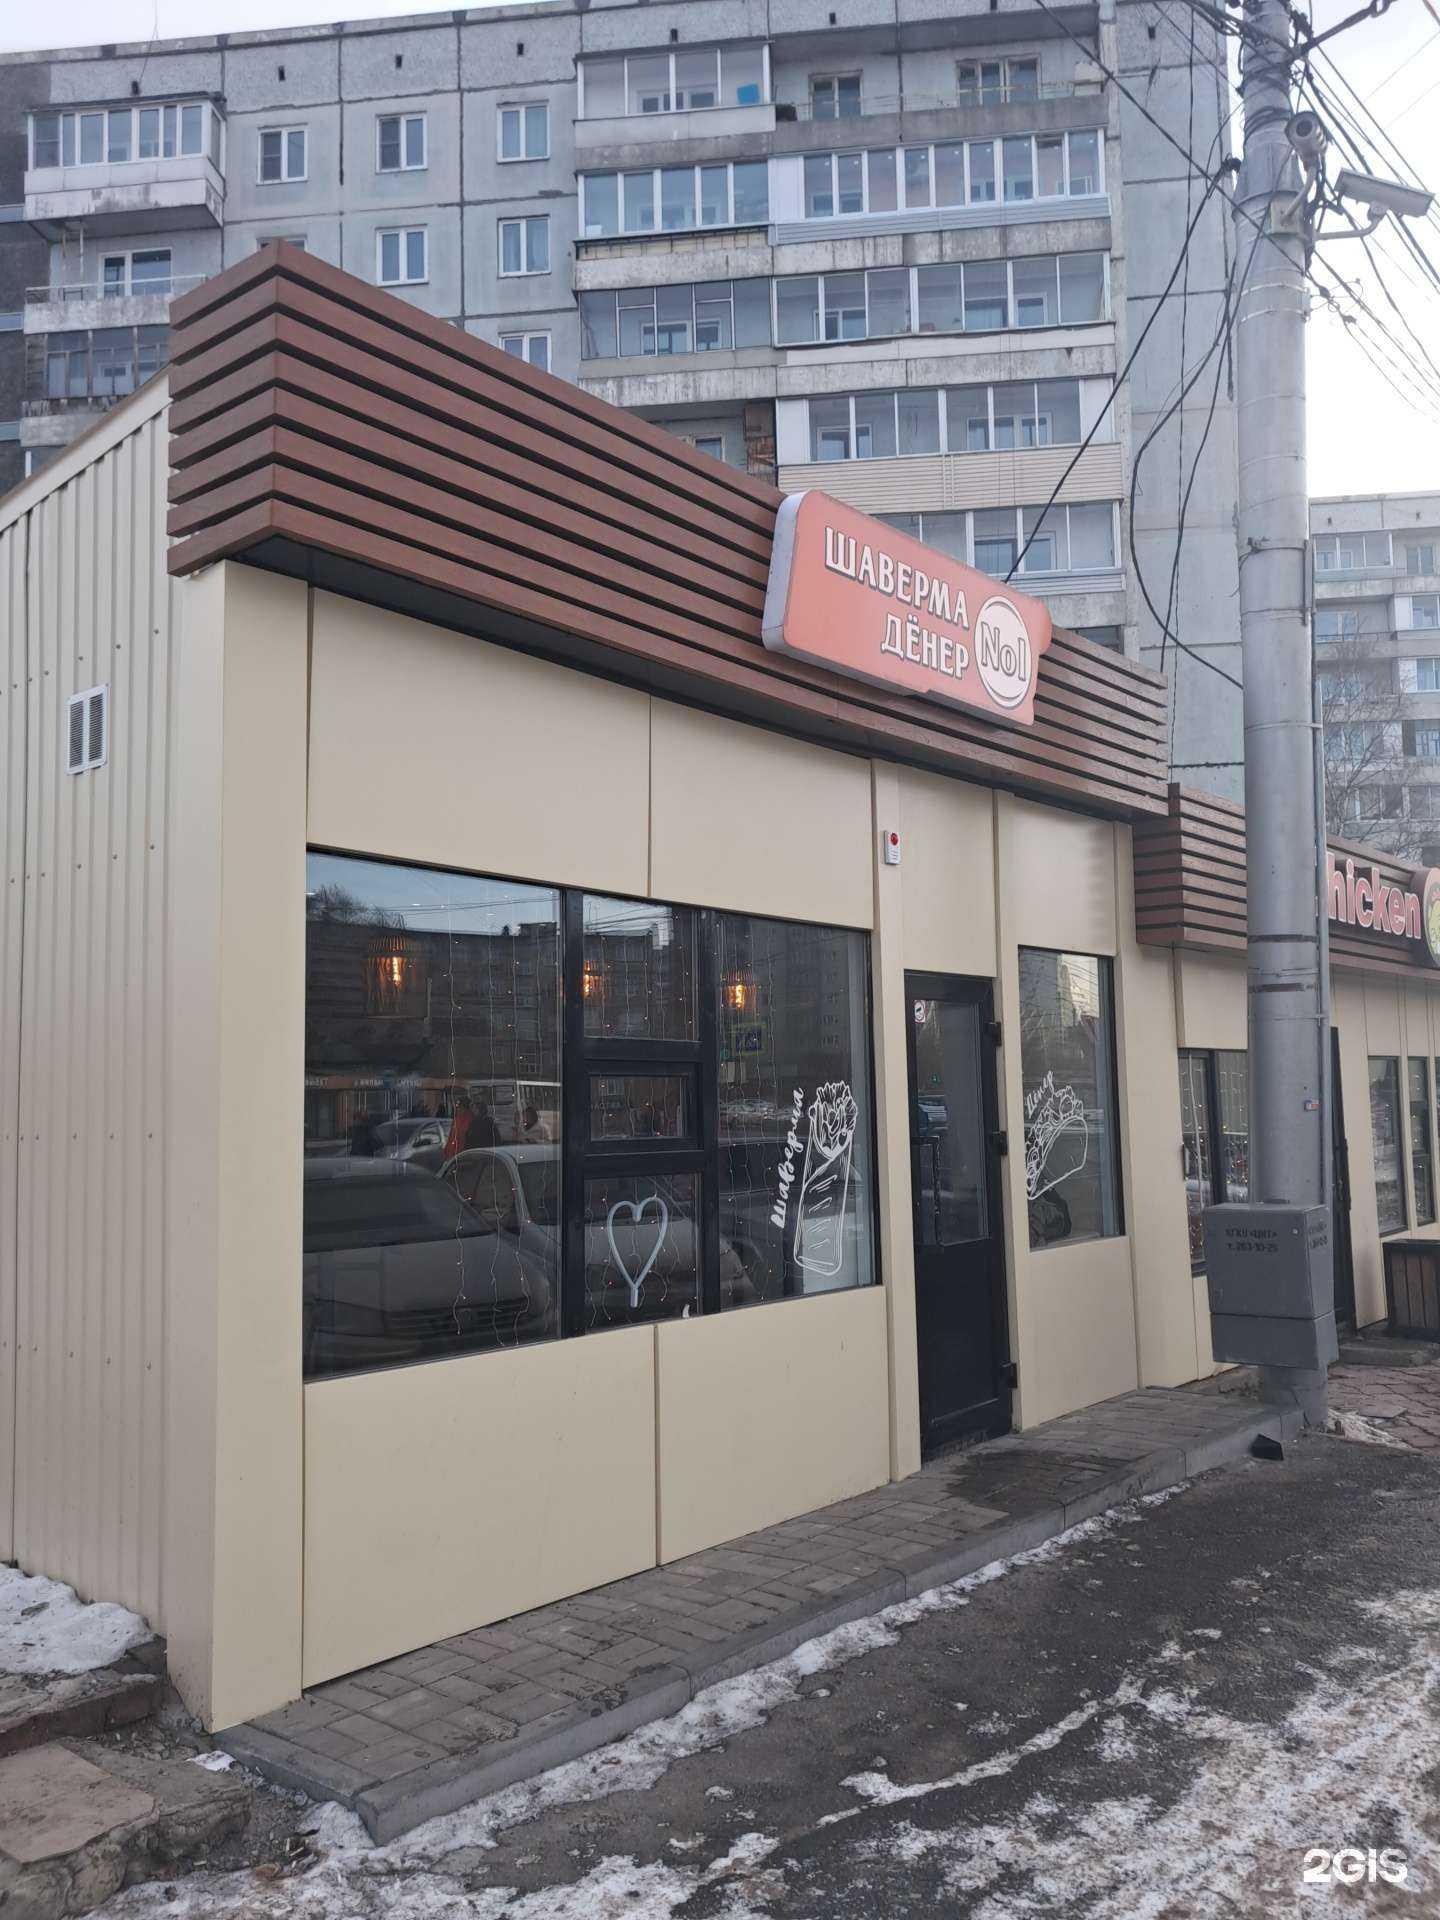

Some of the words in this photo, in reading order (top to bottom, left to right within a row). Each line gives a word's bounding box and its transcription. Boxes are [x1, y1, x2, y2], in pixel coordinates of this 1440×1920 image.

[825, 526, 970, 630] ШАВЕРМА
[881, 613, 970, 680] ДЁНЕР
[1327, 851, 1421, 939] hicken
